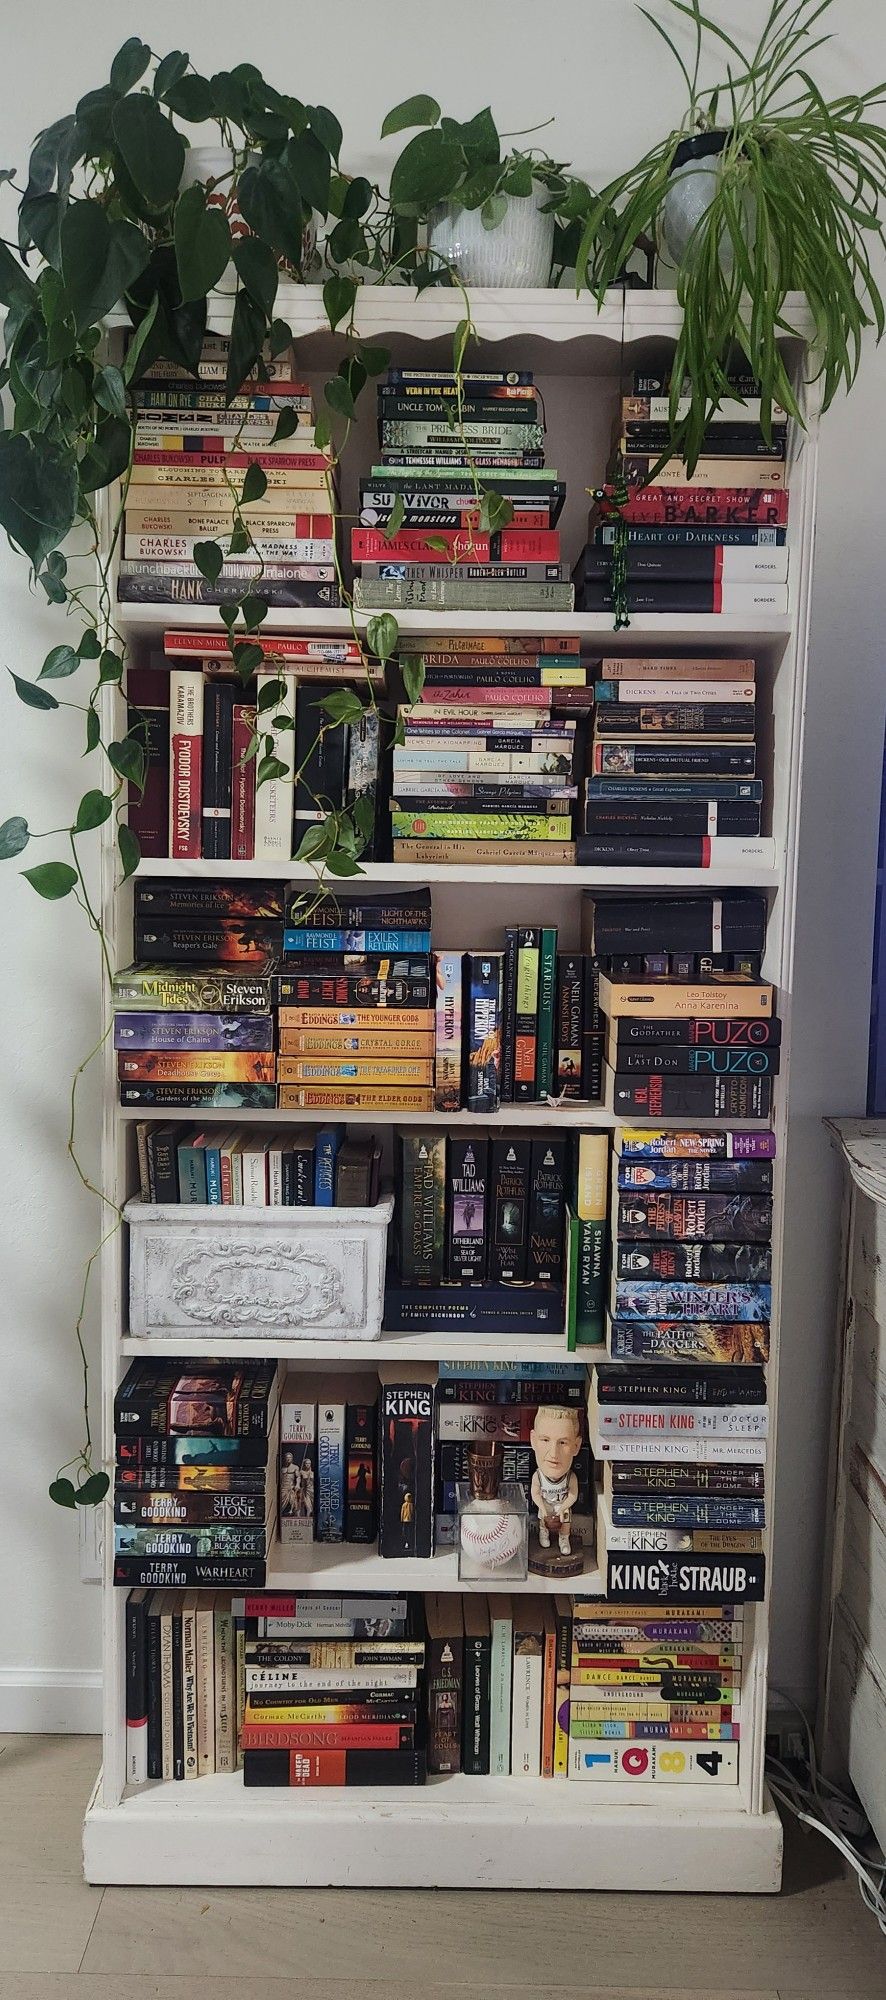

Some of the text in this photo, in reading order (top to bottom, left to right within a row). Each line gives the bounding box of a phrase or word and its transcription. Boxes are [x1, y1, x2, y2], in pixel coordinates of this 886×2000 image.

[151, 393, 192, 407] HAM ON RYE
[398, 403, 423, 411] UNCLE
[482, 426, 512, 435] BRIDE
[201, 456, 226, 464] PULP
[664, 507, 778, 523] BARKER
[628, 532, 662, 541] HEART
[686, 532, 739, 542] DARKNESS
[140, 539, 187, 547] CHARLES
[407, 567, 463, 579] THEY WHISPER
[171, 579, 203, 600] HANK
[177, 686, 185, 725] KARAMAZOV
[177, 740, 191, 841] FYODOR DOSTOEVSKY
[306, 939, 337, 948] FEIST
[368, 942, 398, 950] RETURN
[142, 981, 196, 995] Midnight
[543, 954, 552, 1012] STARDUST
[226, 984, 263, 994] Steven
[160, 992, 188, 1007] Tides
[223, 995, 265, 1006] Erikson
[701, 992, 728, 1000] Tolstoy
[700, 1002, 739, 1010] Karenina
[402, 1014, 419, 1022] GODS
[444, 996, 454, 1040] HYPERION
[571, 981, 580, 1047] NEIL GAIMAN
[630, 1022, 770, 1044] GODFATHER PUZO
[628, 1057, 678, 1066] LAST DON
[694, 1051, 769, 1073] PUZO
[680, 1138, 724, 1147] NEW SPRING
[423, 1162, 433, 1189] TAD
[463, 1164, 475, 1177] TAD
[694, 1163, 702, 1190] Robert
[702, 1164, 710, 1190] Jordan
[414, 1167, 422, 1206] EMPIRE
[453, 1179, 485, 1193] WILLIAMS
[686, 1200, 696, 1236] Robert
[696, 1200, 706, 1236] Jordan
[423, 1195, 435, 1260] WILLIAMS
[414, 1222, 422, 1256] GRASS
[582, 1222, 592, 1285] YANG RYAN
[593, 1230, 601, 1278] SHAWNA
[657, 1331, 686, 1339] PATH
[650, 1340, 704, 1348] DAGGERS
[618, 1385, 660, 1393] STEPHEN
[663, 1386, 687, 1394] KING
[386, 1401, 430, 1416] KING
[619, 1414, 665, 1429] STEPHEN
[669, 1415, 694, 1429] KING
[722, 1415, 767, 1423] DOCTOR
[463, 1421, 497, 1432] KING
[620, 1445, 661, 1453] STEPHEN
[665, 1445, 689, 1453] KING
[634, 1469, 689, 1477] STEPHEN
[647, 1479, 675, 1487] KING
[150, 1498, 178, 1507] TERRY
[214, 1496, 247, 1506] SIEGE
[141, 1507, 186, 1518] GOODKIND
[214, 1506, 255, 1517] STONE
[634, 1503, 689, 1512] STEPHEN
[647, 1514, 675, 1522] KING
[155, 1534, 183, 1543] TERRY
[631, 1538, 667, 1549] KING
[145, 1543, 191, 1553] GOODKIND
[214, 1542, 255, 1550] BLACK ICE
[150, 1563, 178, 1572] TERRY
[196, 1566, 255, 1578] WARHEART
[141, 1573, 187, 1584] GOODKIND
[611, 1565, 659, 1590] KING
[680, 1567, 747, 1591] STRAUB
[185, 1617, 194, 1673] Norman Mailer
[252, 1671, 298, 1681] CÉLINE
[248, 1732, 338, 1745] BIRDSONG
[585, 1754, 611, 1768] 1
[622, 1748, 648, 1775] Q
[659, 1751, 686, 1774] 8
[696, 1751, 722, 1776] 4
